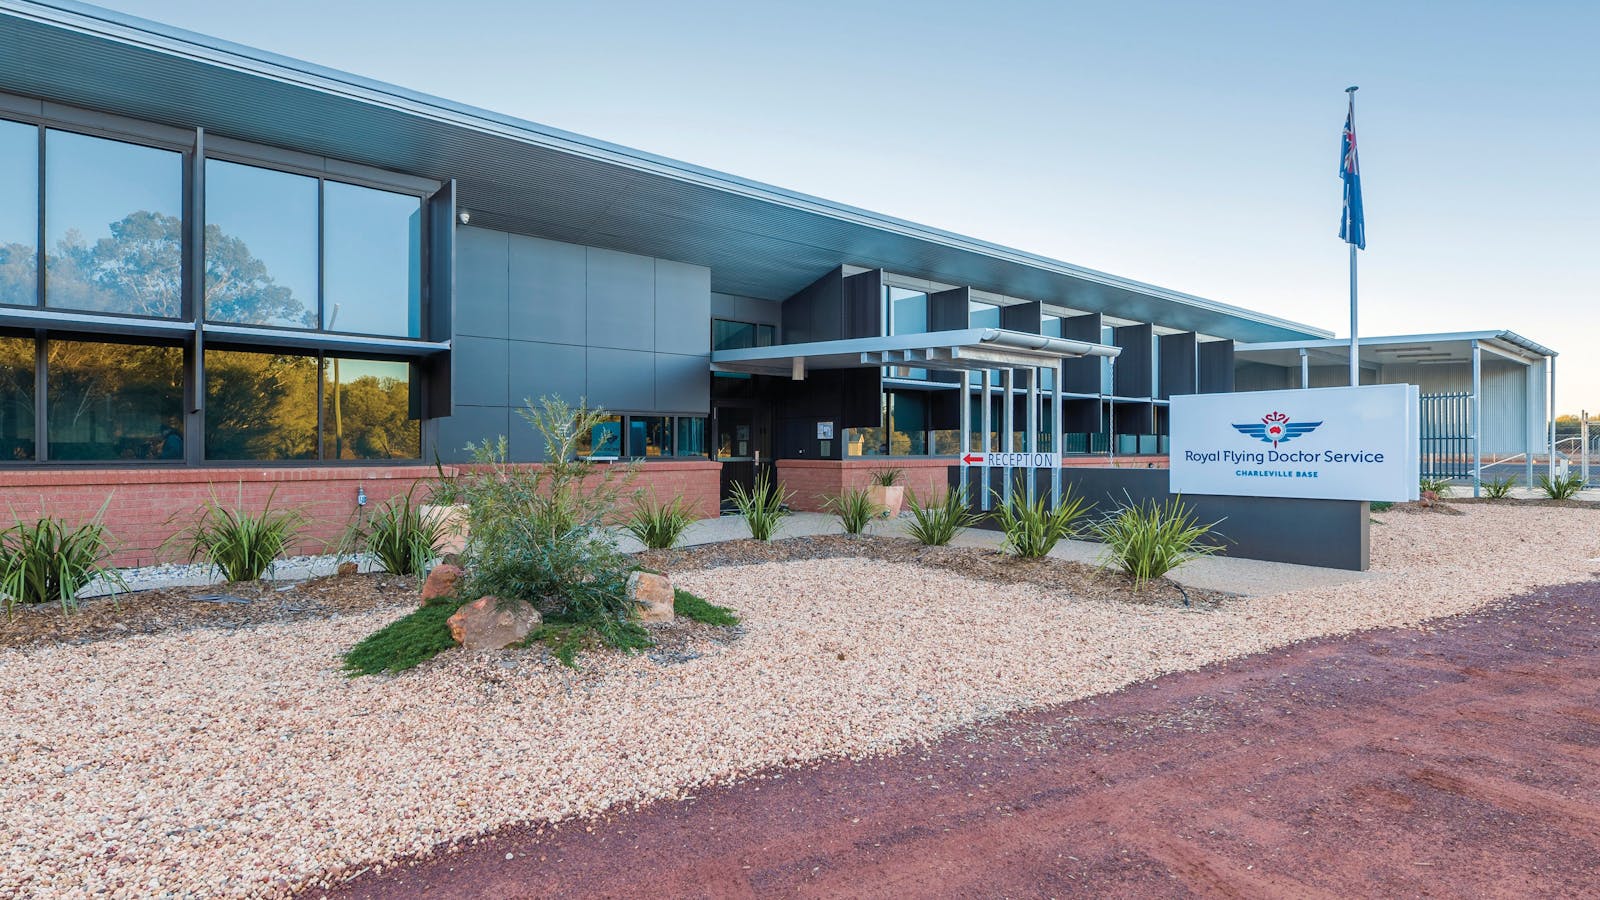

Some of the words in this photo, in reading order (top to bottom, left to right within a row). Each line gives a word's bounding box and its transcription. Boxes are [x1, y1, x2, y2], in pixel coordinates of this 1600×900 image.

[988, 453, 1053, 467] RECEPTION
[1185, 450, 1220, 464] Royal
[1223, 450, 1264, 465] Flying
[1268, 450, 1321, 463] Doctor
[1324, 450, 1384, 463] Service
[1235, 470, 1293, 478] CHARLEVILLE
